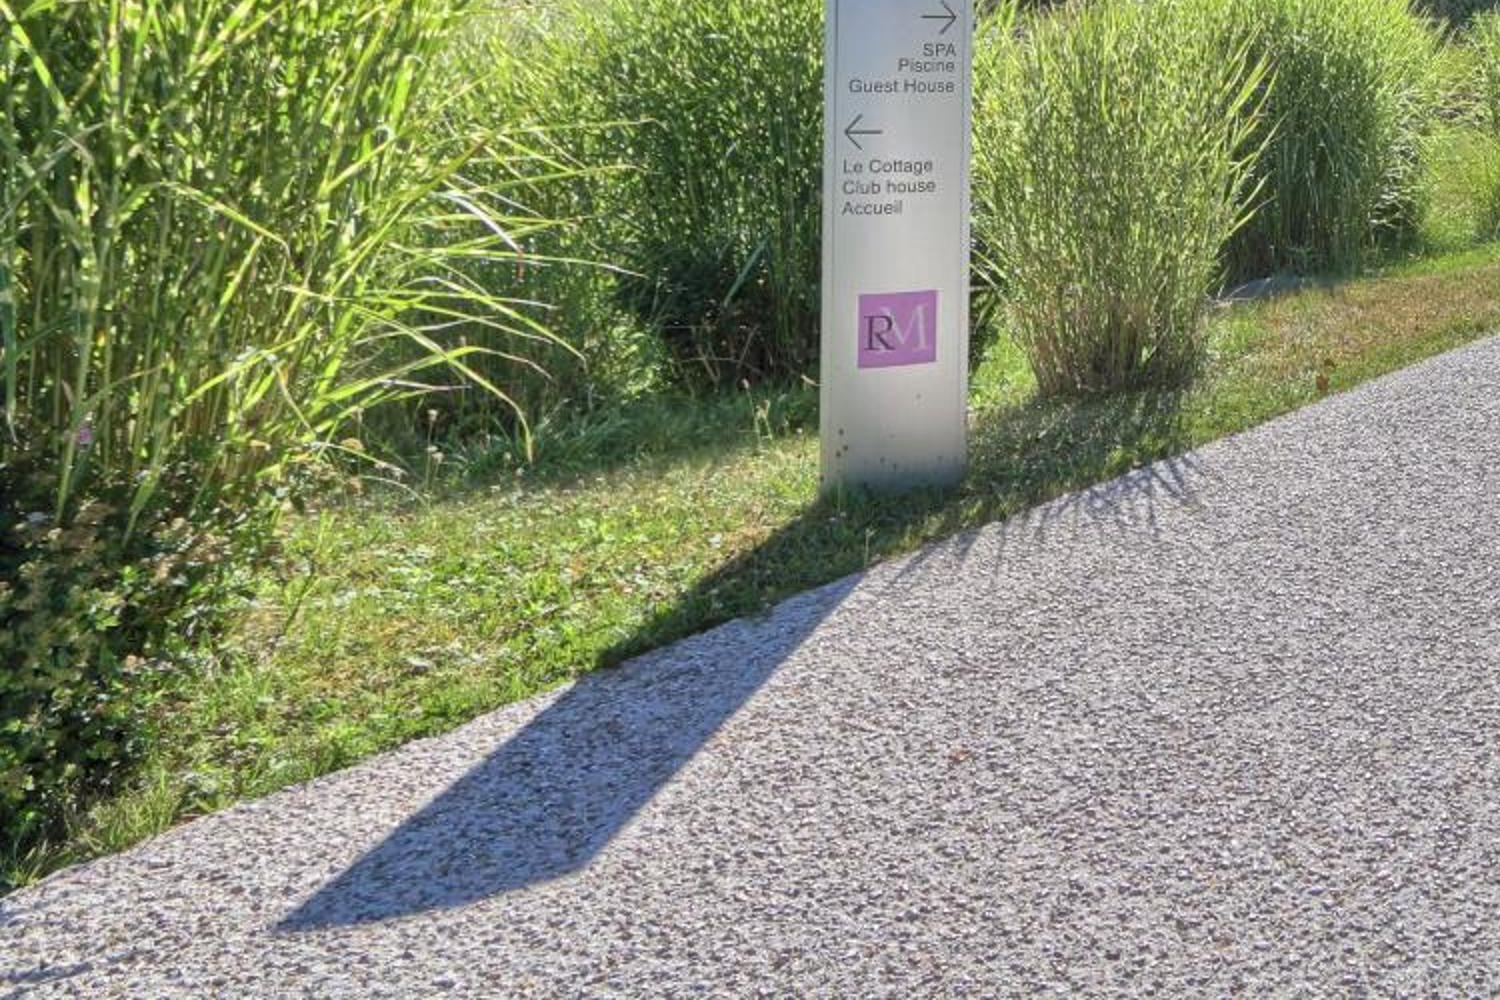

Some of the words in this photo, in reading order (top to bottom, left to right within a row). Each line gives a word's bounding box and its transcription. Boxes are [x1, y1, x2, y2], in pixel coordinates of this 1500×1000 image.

[923, 43, 956, 57] SPA
[898, 57, 954, 73] Piscine
[849, 79, 898, 93] Guest
[903, 78, 954, 93] House
[843, 159, 863, 174] Le
[869, 159, 933, 176] Cottage
[842, 180, 881, 195] Club
[886, 179, 936, 193] house
[842, 199, 902, 216] Accueil
